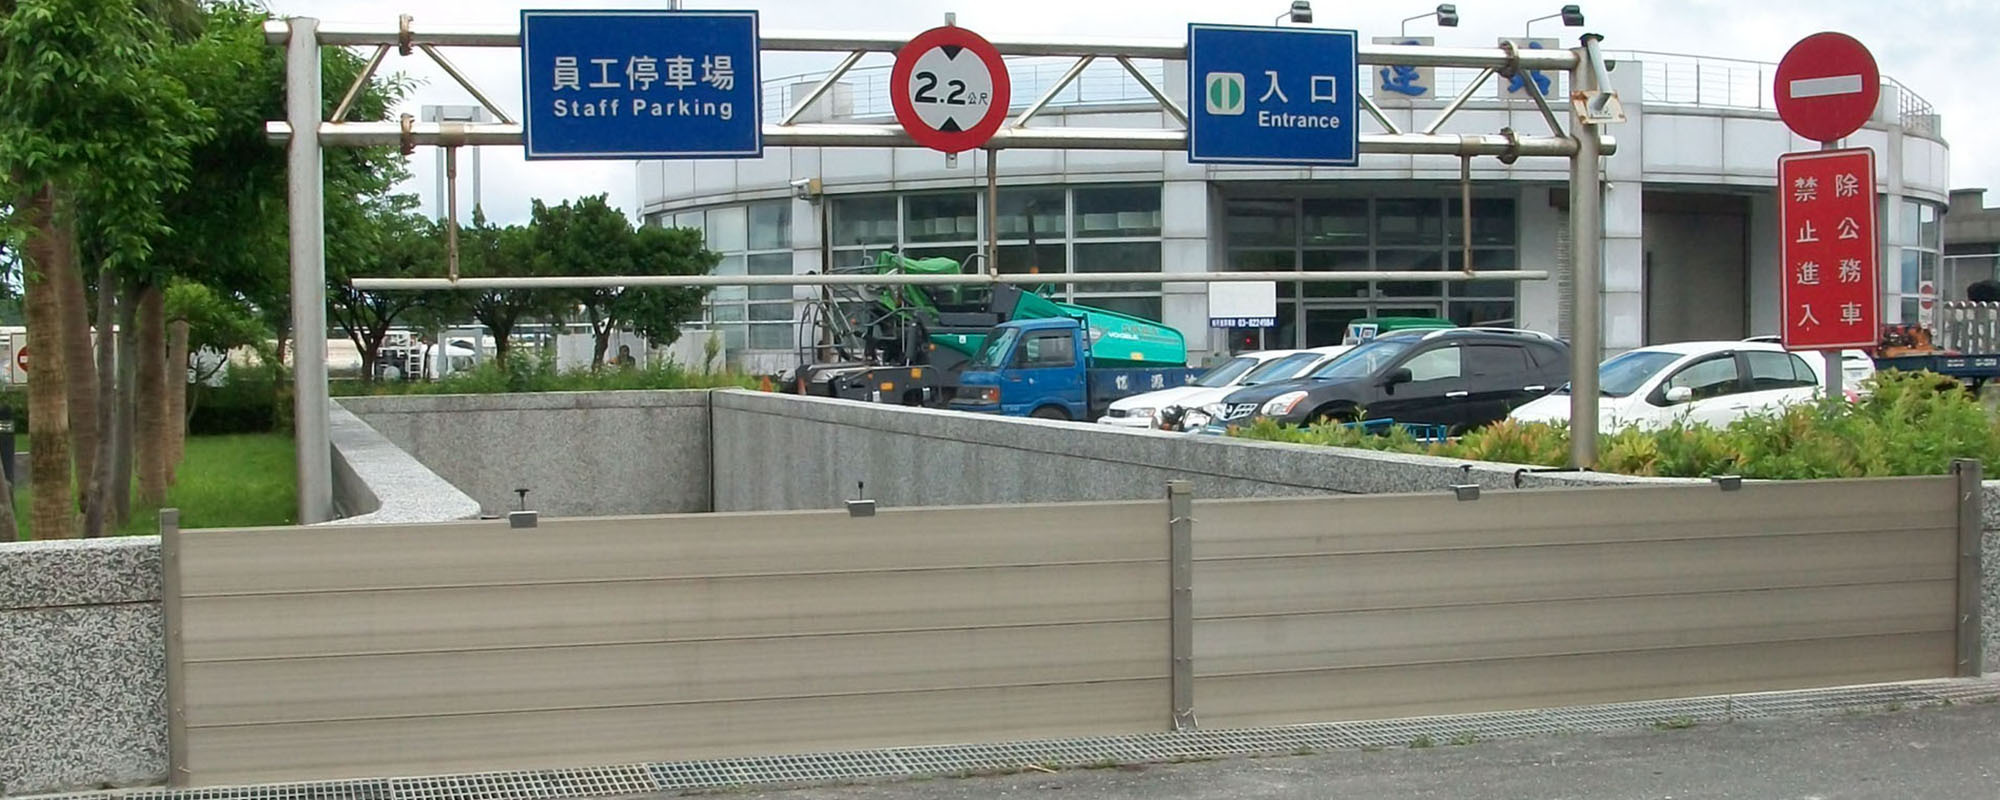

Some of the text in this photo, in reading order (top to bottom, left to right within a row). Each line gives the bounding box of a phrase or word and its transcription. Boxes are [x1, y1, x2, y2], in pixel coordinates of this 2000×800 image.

[553, 55, 735, 91] 員工停車場
[1258, 71, 1338, 104] 入口
[553, 99, 733, 120] Staff Parking
[1258, 110, 1341, 129] Entrance
[1794, 177, 1820, 328] 禁止進入
[1835, 173, 1863, 325] 除公務車
